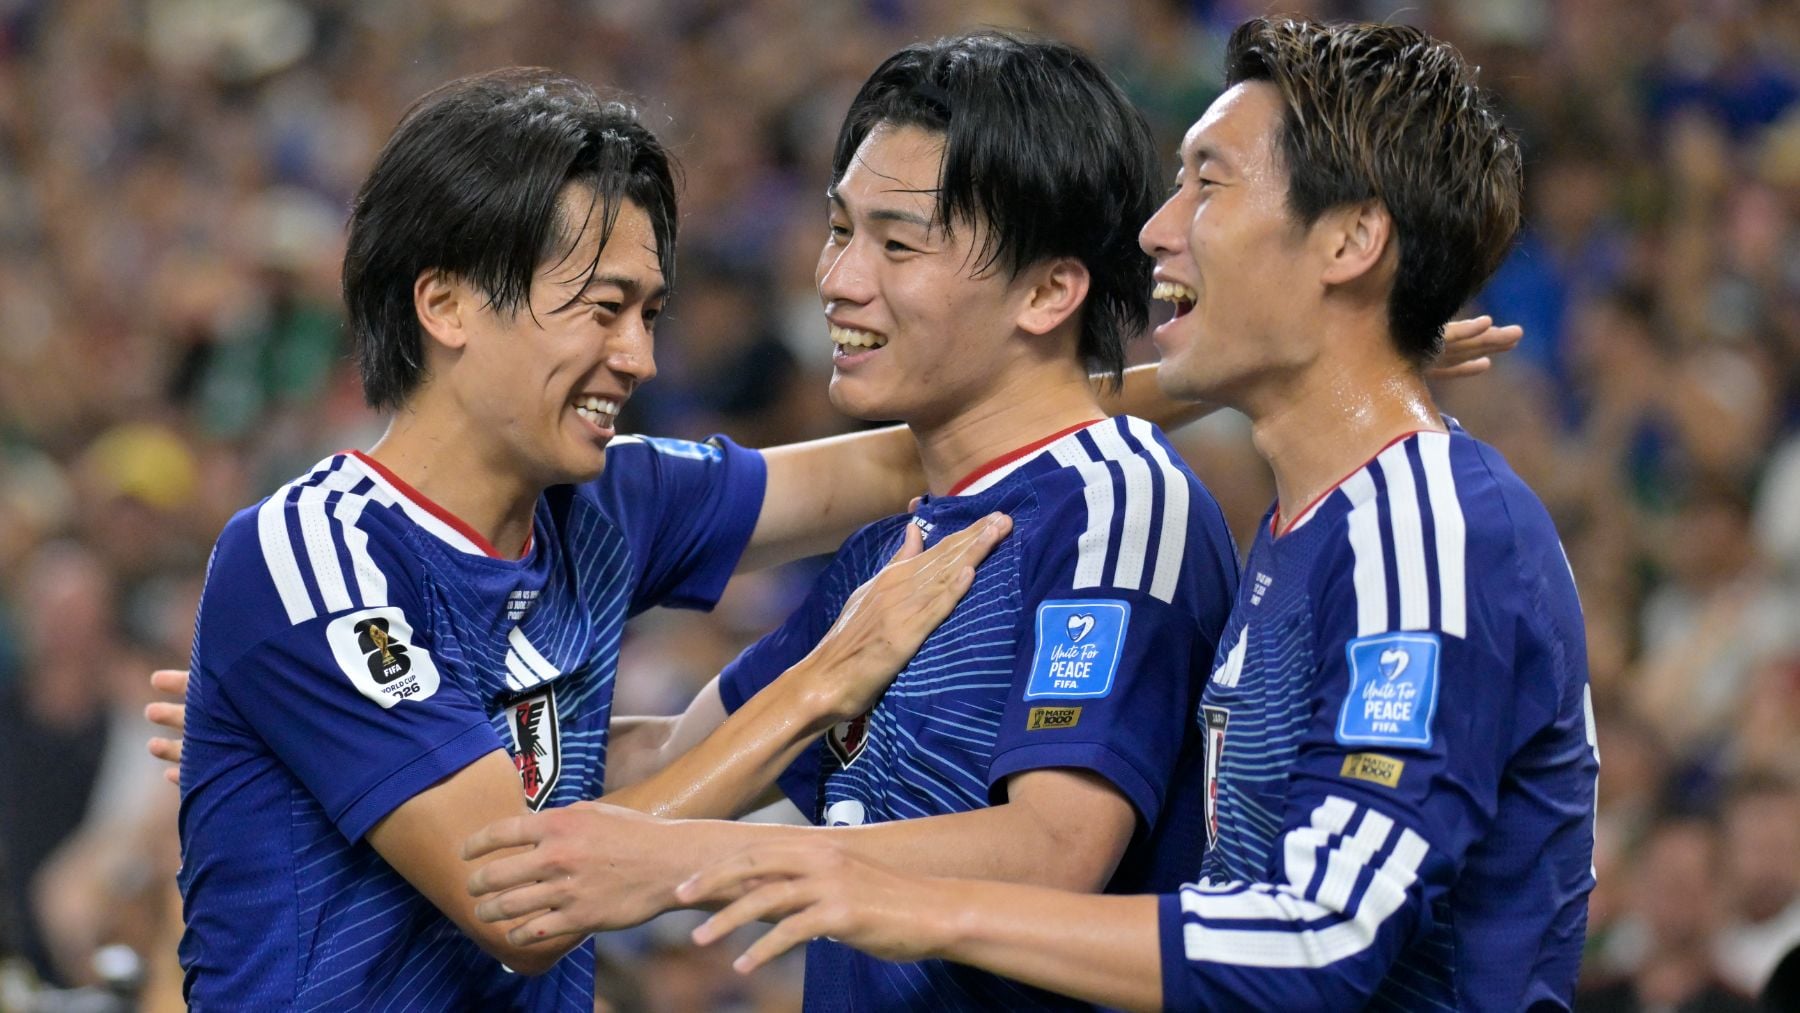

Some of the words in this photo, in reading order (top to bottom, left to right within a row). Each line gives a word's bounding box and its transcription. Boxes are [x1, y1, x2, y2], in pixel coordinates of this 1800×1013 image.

[1051, 644, 1080, 661] Unite
[1081, 644, 1099, 660] For
[384, 664, 402, 677] FIFA
[1048, 661, 1093, 678] PEACE
[405, 675, 416, 684] CUP
[1054, 680, 1077, 689] FIFA
[1362, 680, 1396, 700] Unite
[1397, 682, 1416, 699] For
[1364, 701, 1412, 720] PEACE
[1043, 716, 1073, 724] 1000
[1372, 722, 1399, 733] FIFA
